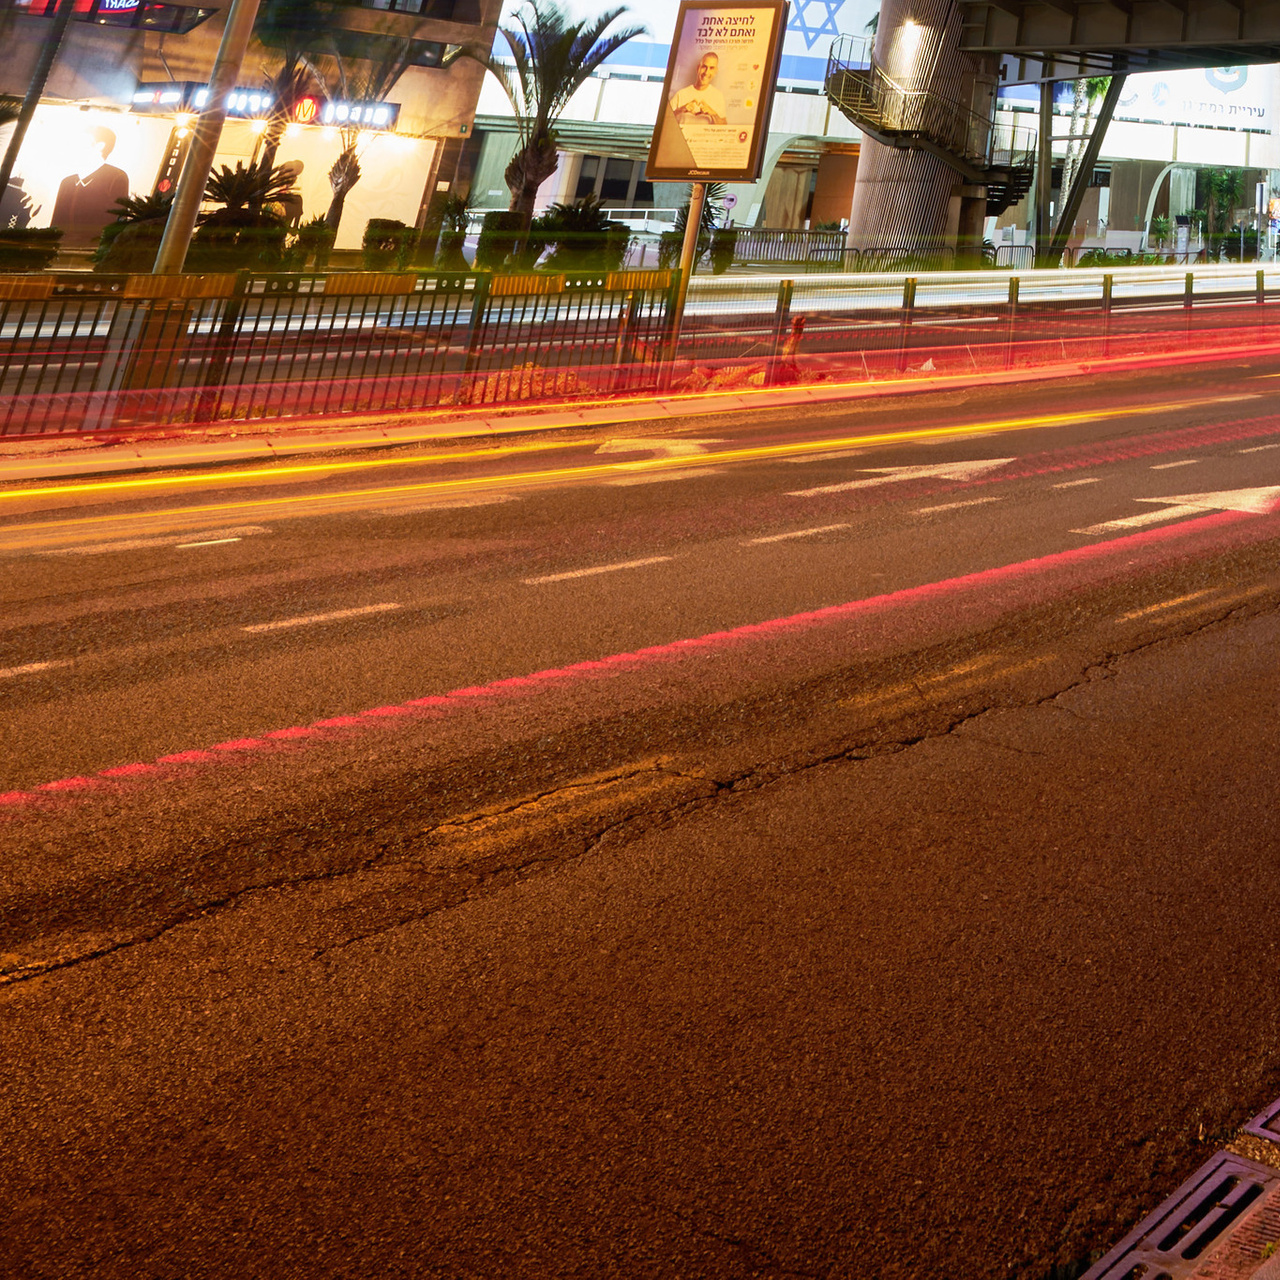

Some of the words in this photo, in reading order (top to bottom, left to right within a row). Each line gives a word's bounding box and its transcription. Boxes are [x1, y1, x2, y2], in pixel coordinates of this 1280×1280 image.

[702, 16, 724, 26] אחת
[725, 14, 755, 25] לחיצה
[697, 26, 714, 37] לבד
[715, 26, 728, 37] לא
[730, 28, 755, 37] ואתם
[1228, 104, 1265, 118] עיריית
